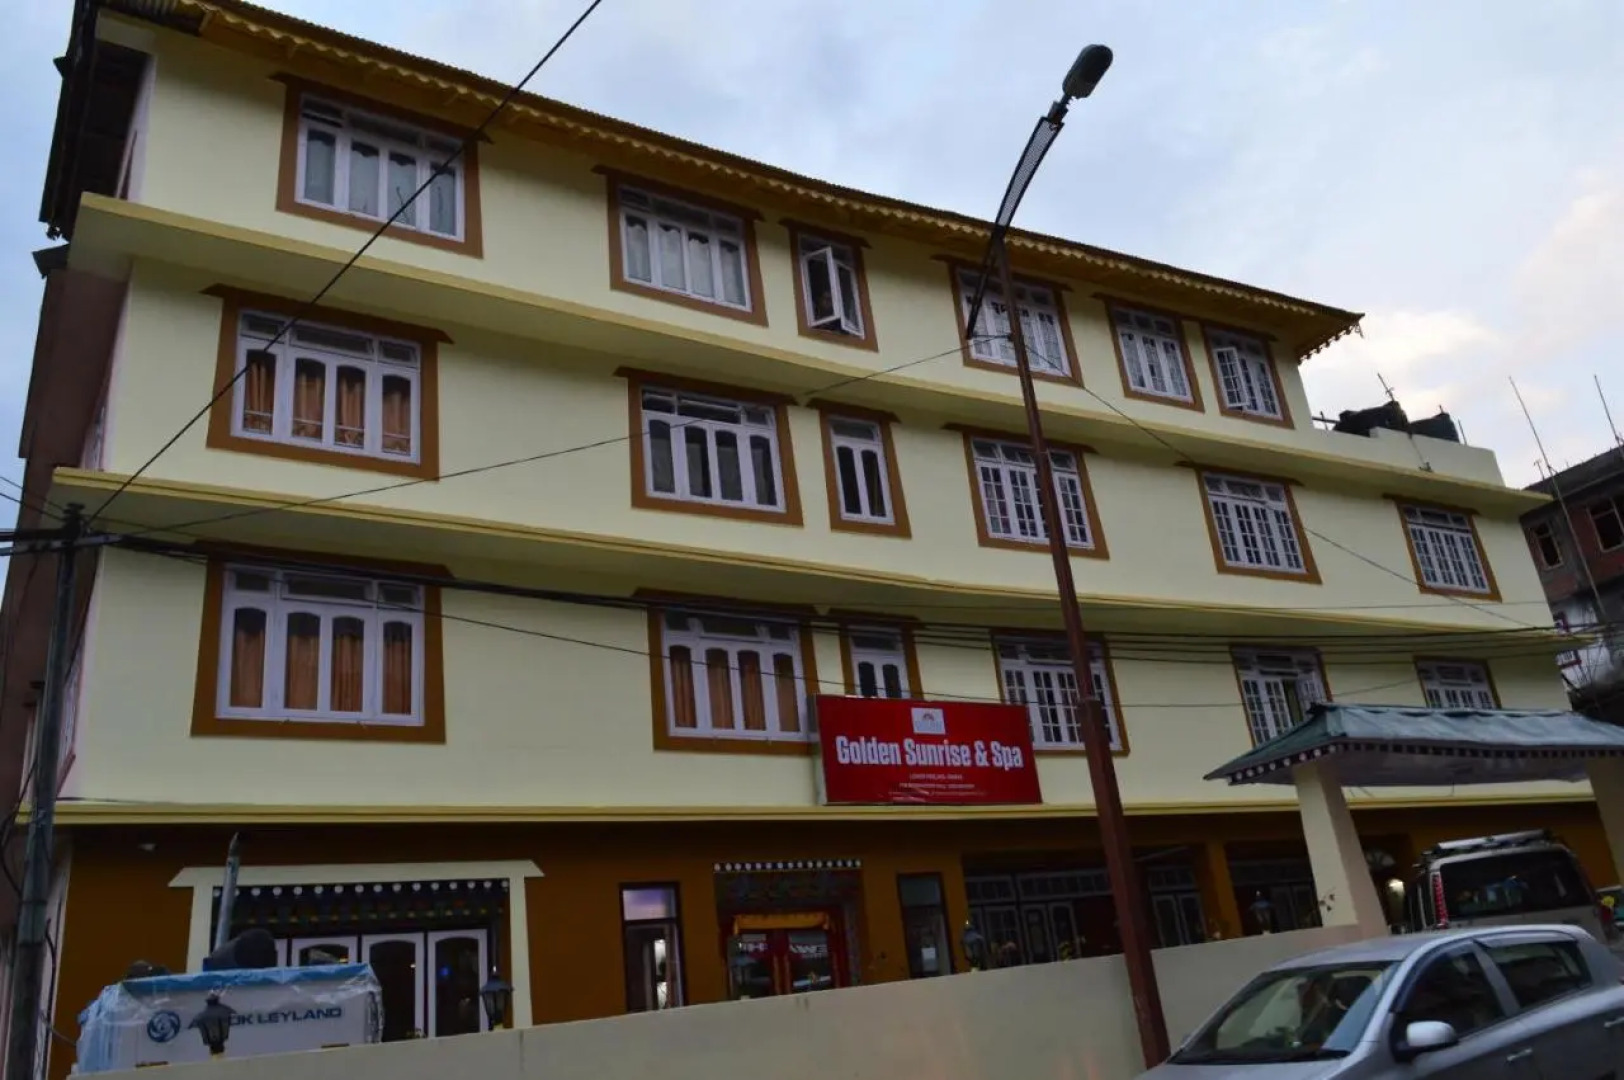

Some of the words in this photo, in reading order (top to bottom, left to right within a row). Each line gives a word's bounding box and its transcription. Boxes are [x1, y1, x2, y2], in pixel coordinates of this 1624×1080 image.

[836, 736, 902, 765] Golden
[904, 739, 971, 767] Sunrise
[974, 741, 989, 767] &
[990, 741, 1024, 770] Spa
[257, 1007, 343, 1024] LEYLAND
